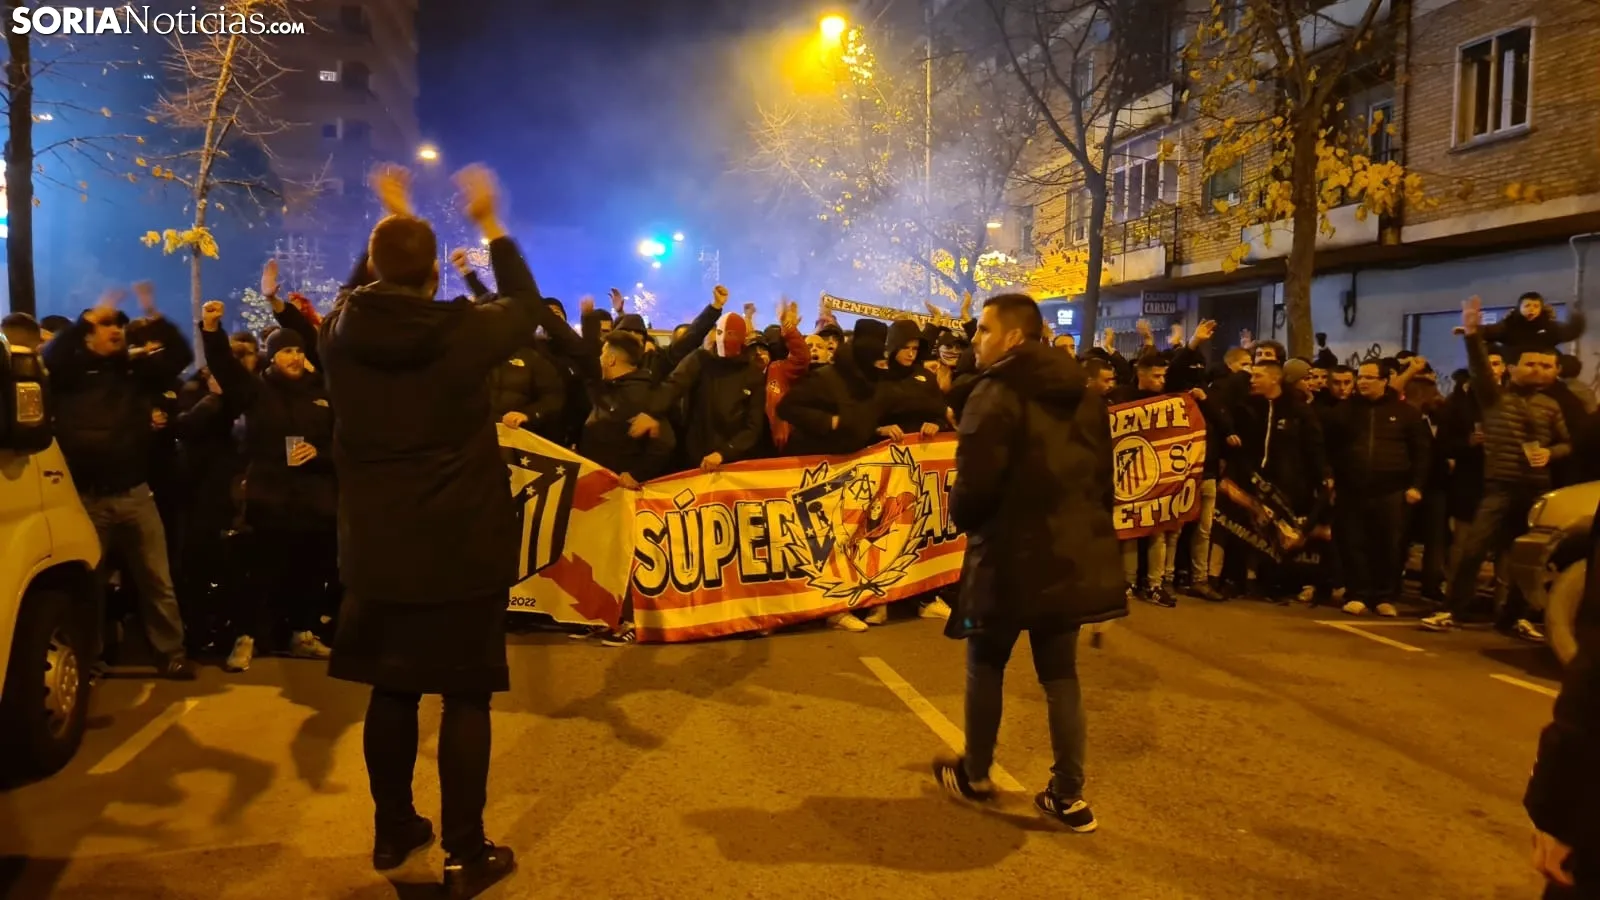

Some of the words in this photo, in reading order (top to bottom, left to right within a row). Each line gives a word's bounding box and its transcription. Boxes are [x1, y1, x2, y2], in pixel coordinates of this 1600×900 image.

[823, 296, 880, 317] FRENTE
[1144, 302, 1176, 314] CARAZO
[633, 488, 801, 595] SÚPER
